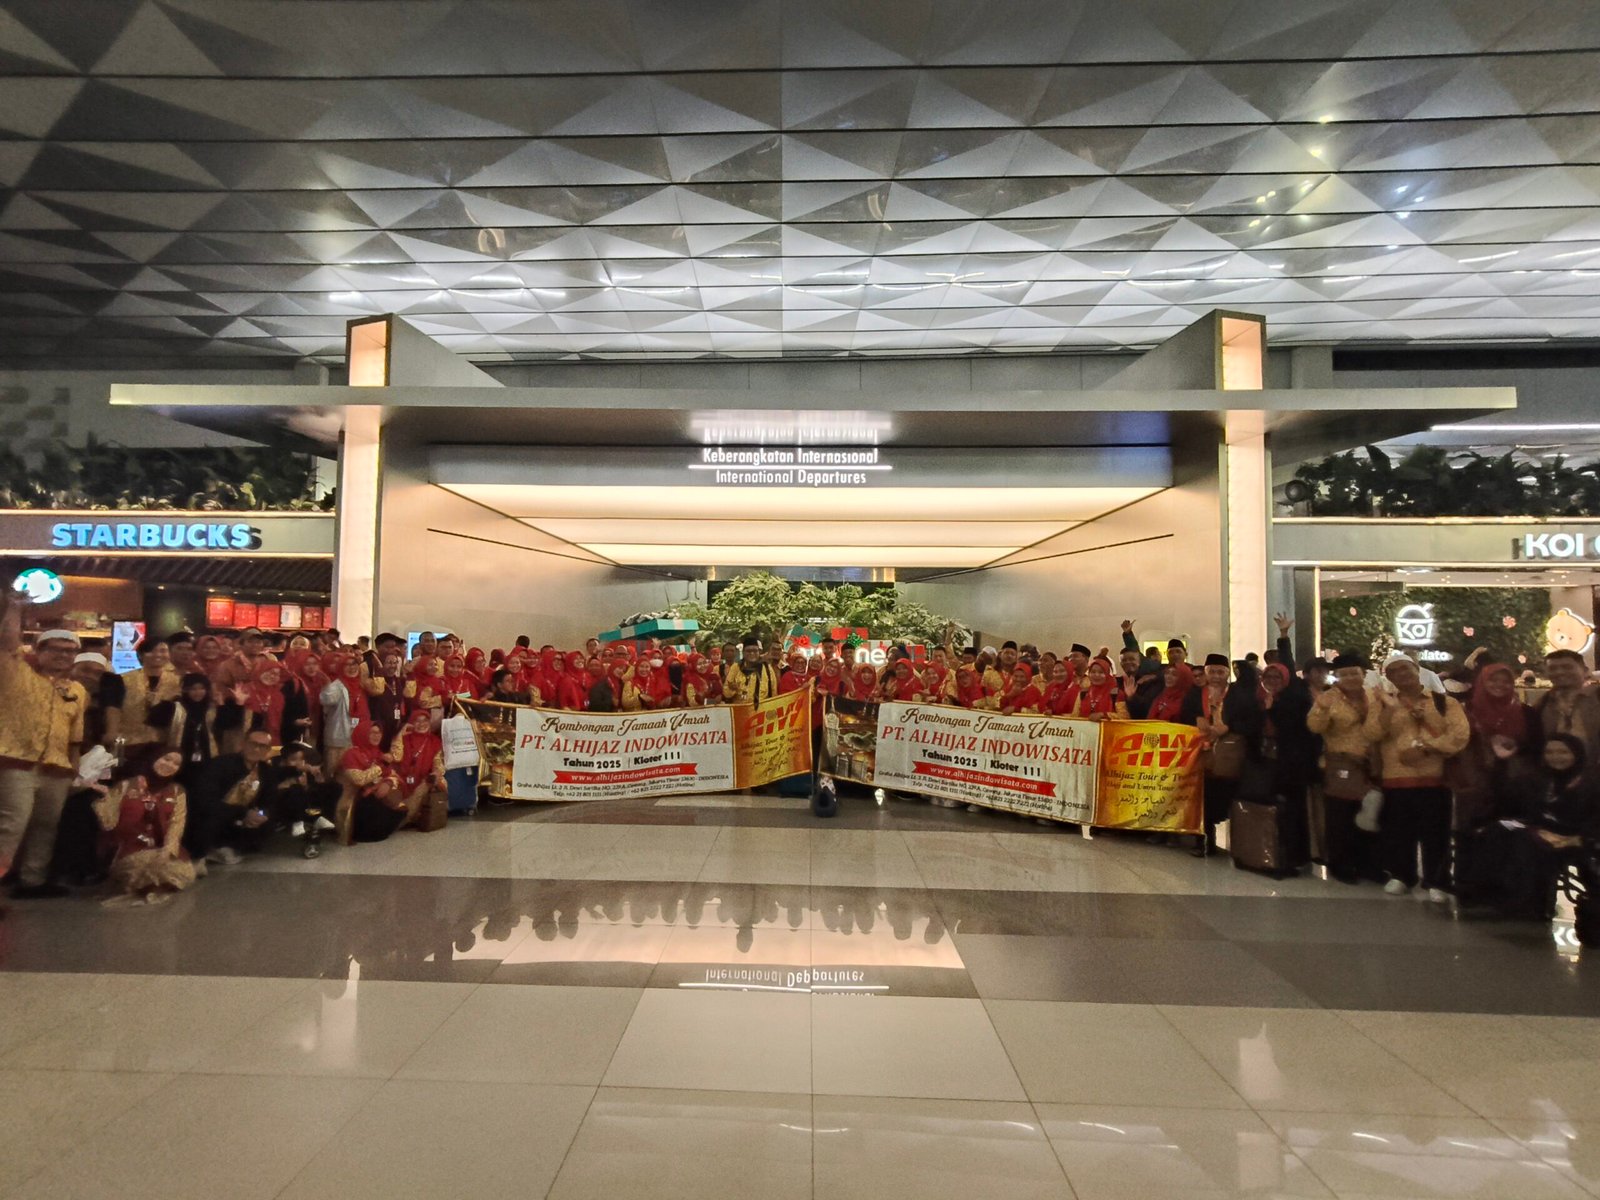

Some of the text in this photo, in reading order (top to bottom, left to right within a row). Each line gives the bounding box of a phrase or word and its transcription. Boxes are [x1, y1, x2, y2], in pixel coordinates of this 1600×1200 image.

[703, 448, 878, 465] Keberangkatan Internasional
[716, 469, 867, 486] International Departures
[52, 523, 250, 547] STARBUCKS
[1525, 533, 1584, 557] KOI
[540, 713, 710, 737] Rombongan Jamaah Umrah
[900, 708, 1074, 739] Rombongan Jamaah Umrah
[520, 730, 728, 757] PT. ALHIJAZ INDOWISATA
[881, 726, 1093, 766] PT. ALHIJAZ INDOWISATA
[563, 757, 594, 768] Tahun
[596, 759, 621, 769] 2025
[922, 749, 952, 763] Tahun
[953, 757, 978, 768] 2025
[990, 759, 1019, 773] Kloter
[571, 765, 681, 782] www.alhijazindowisata.com
[929, 766, 1038, 791] www.alhijazindowisata.com
[1138, 771, 1157, 781] Tour
